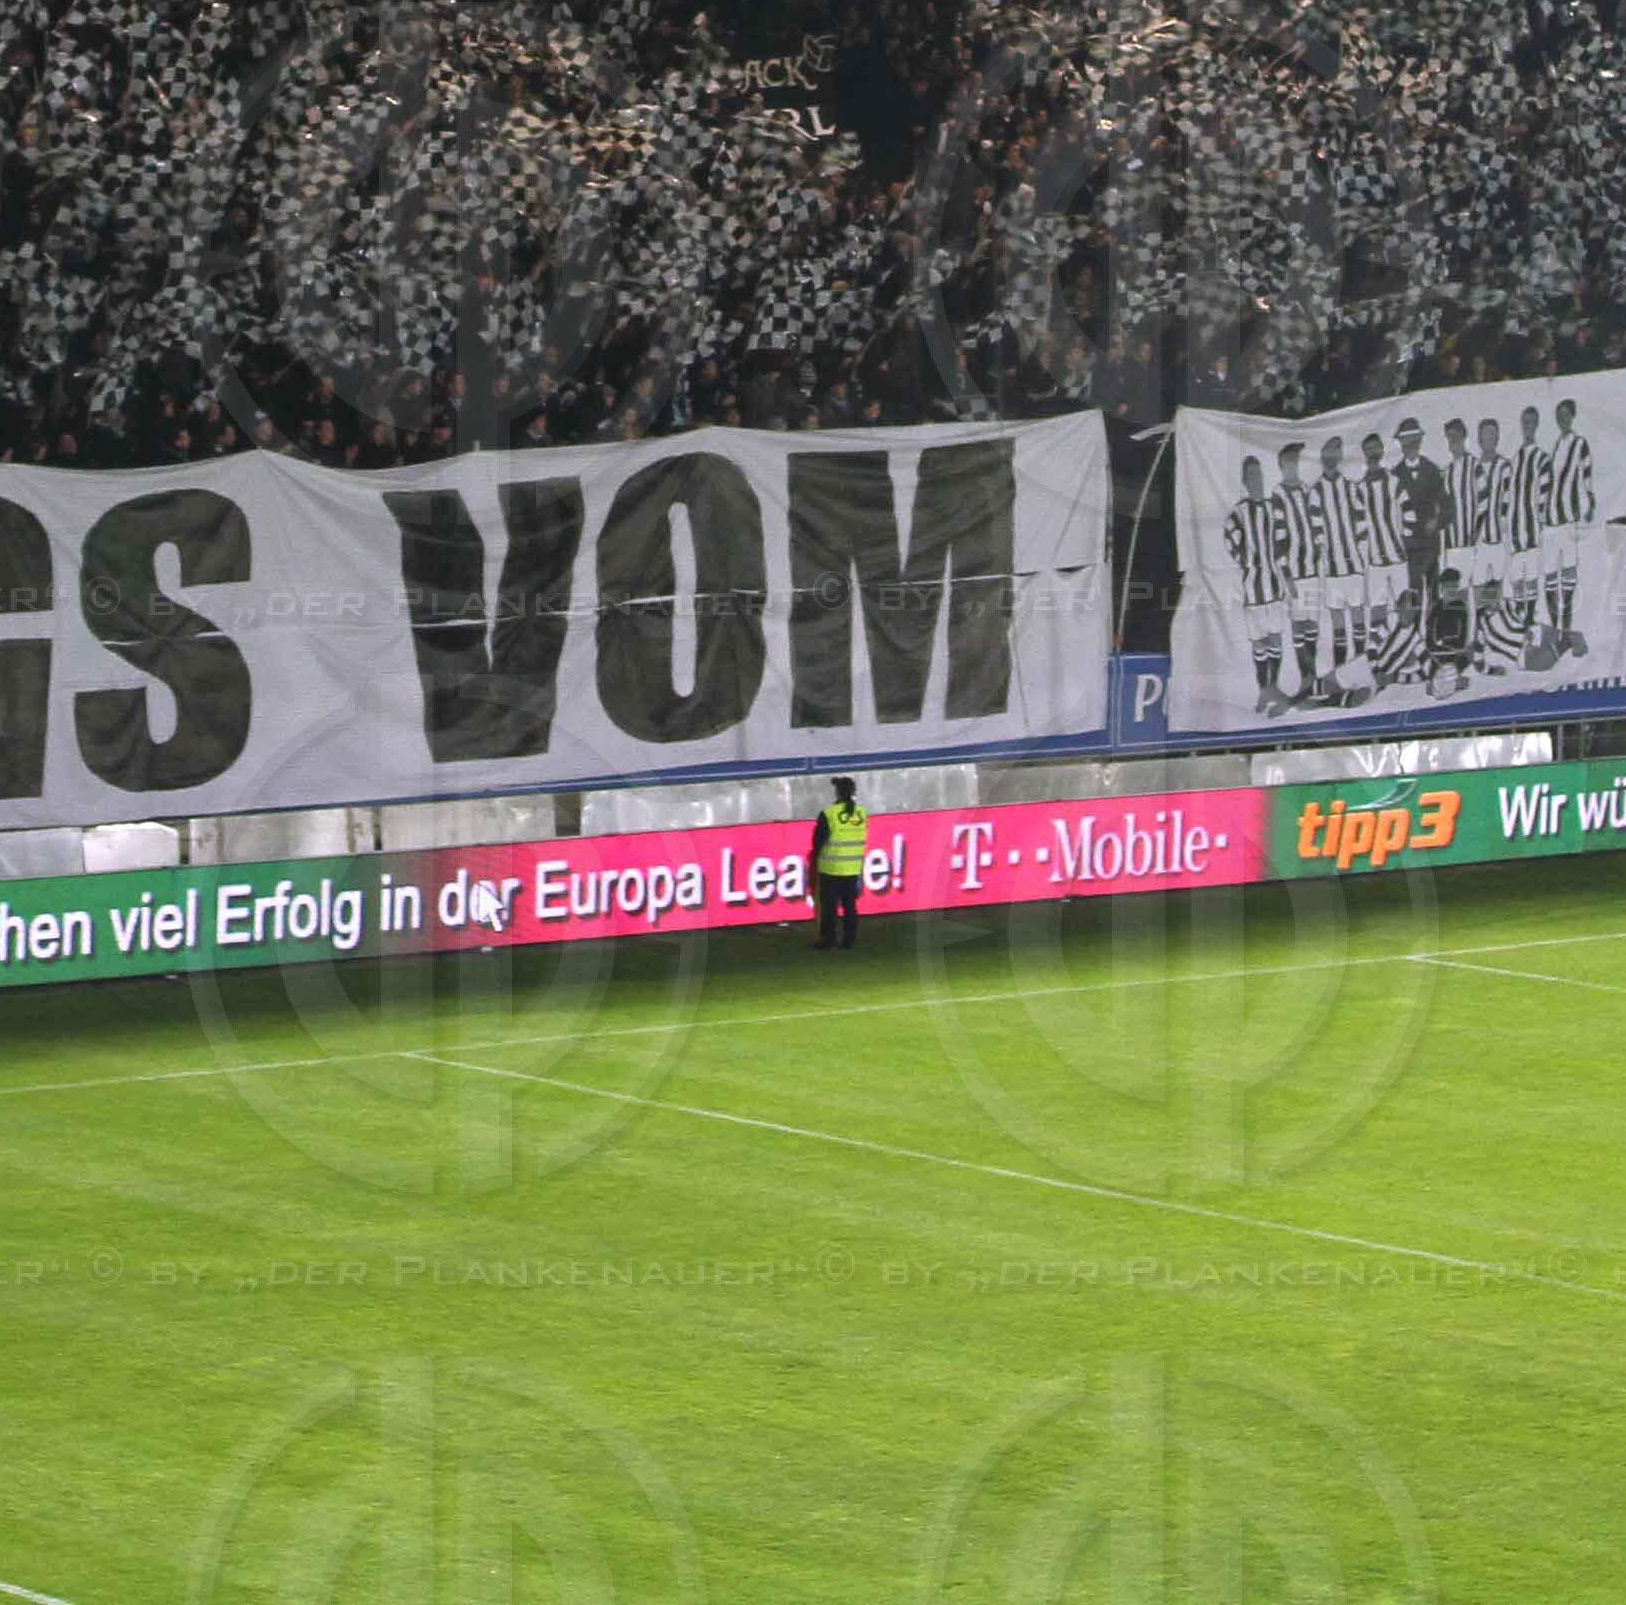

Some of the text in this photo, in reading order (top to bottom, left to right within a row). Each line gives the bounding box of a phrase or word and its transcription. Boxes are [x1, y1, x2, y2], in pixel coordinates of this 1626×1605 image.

[381, 438, 1017, 763] VOM
[1296, 790, 1462, 871] tipp3
[1499, 786, 1567, 838] Wir
[109, 886, 198, 952] viel
[216, 877, 362, 951] Erfolg
[380, 874, 421, 931] in
[535, 856, 702, 928] Europa
[720, 836, 905, 908] Leae!
